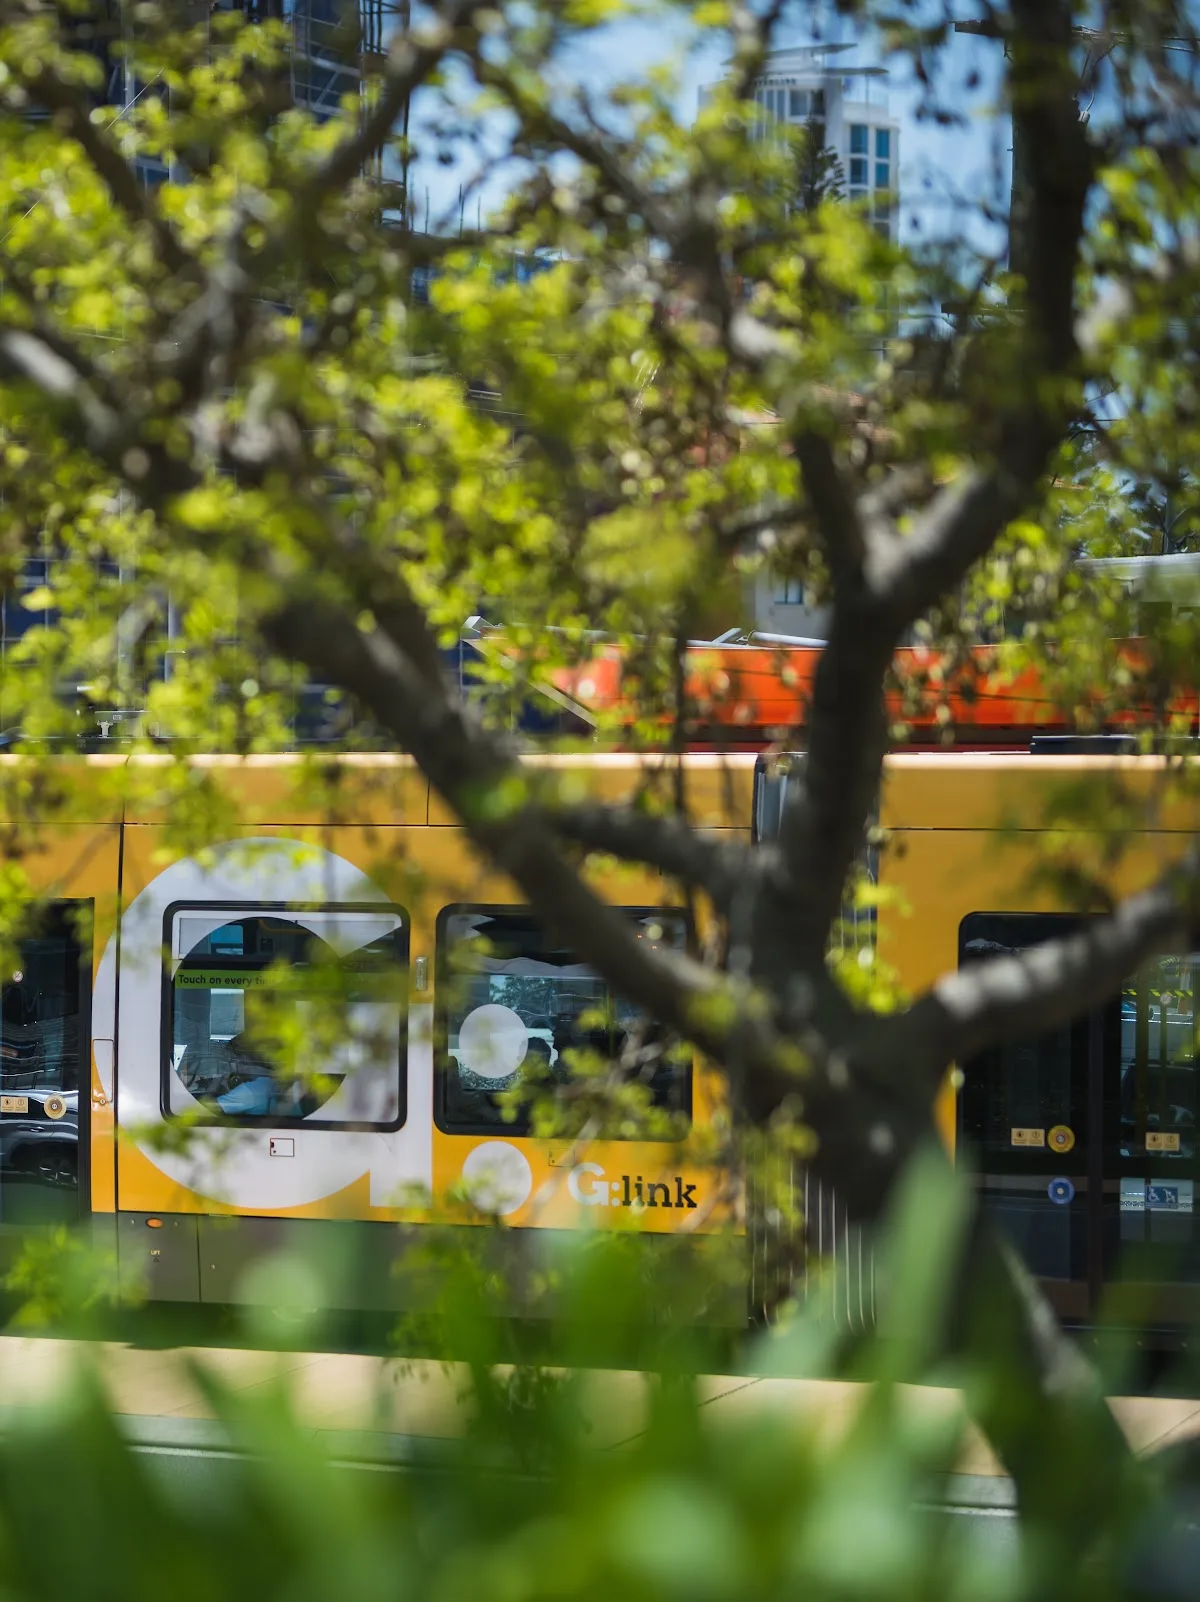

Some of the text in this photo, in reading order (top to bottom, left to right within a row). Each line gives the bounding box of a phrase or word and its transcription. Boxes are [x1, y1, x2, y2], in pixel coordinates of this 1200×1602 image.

[178, 974, 206, 985] Touch
[210, 976, 222, 985] on
[224, 976, 252, 988] every
[567, 1161, 698, 1209] G:link
